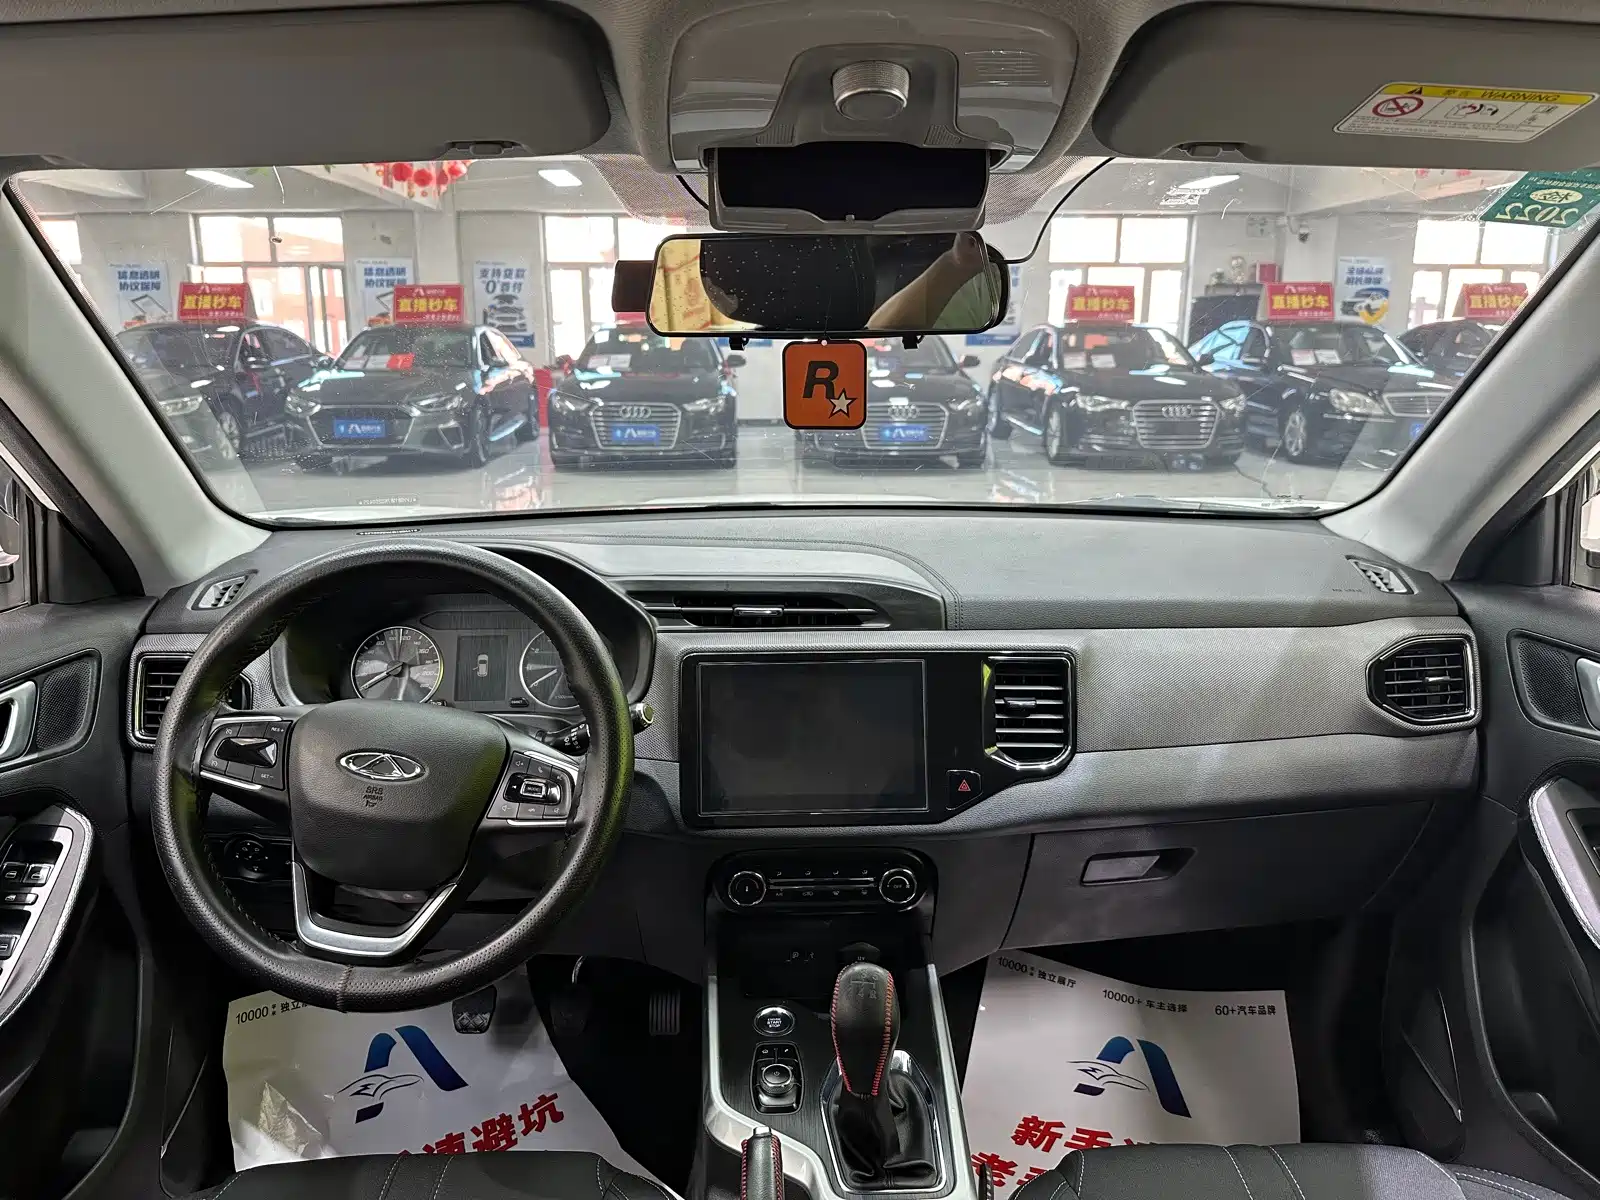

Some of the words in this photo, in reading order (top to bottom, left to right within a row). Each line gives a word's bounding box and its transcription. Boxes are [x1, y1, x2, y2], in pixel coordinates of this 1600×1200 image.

[1480, 90, 1560, 102] WARNING
[479, 268, 527, 279] 支持贷款
[803, 361, 839, 399] R
[366, 785, 384, 795] SRS
[995, 956, 1028, 973] 10000
[1038, 969, 1077, 988] 独立展厅
[235, 1005, 269, 1025] 10000
[280, 1000, 308, 1014] 独立
[1102, 988, 1142, 1005] 10000+
[1145, 998, 1188, 1013] 车主选择
